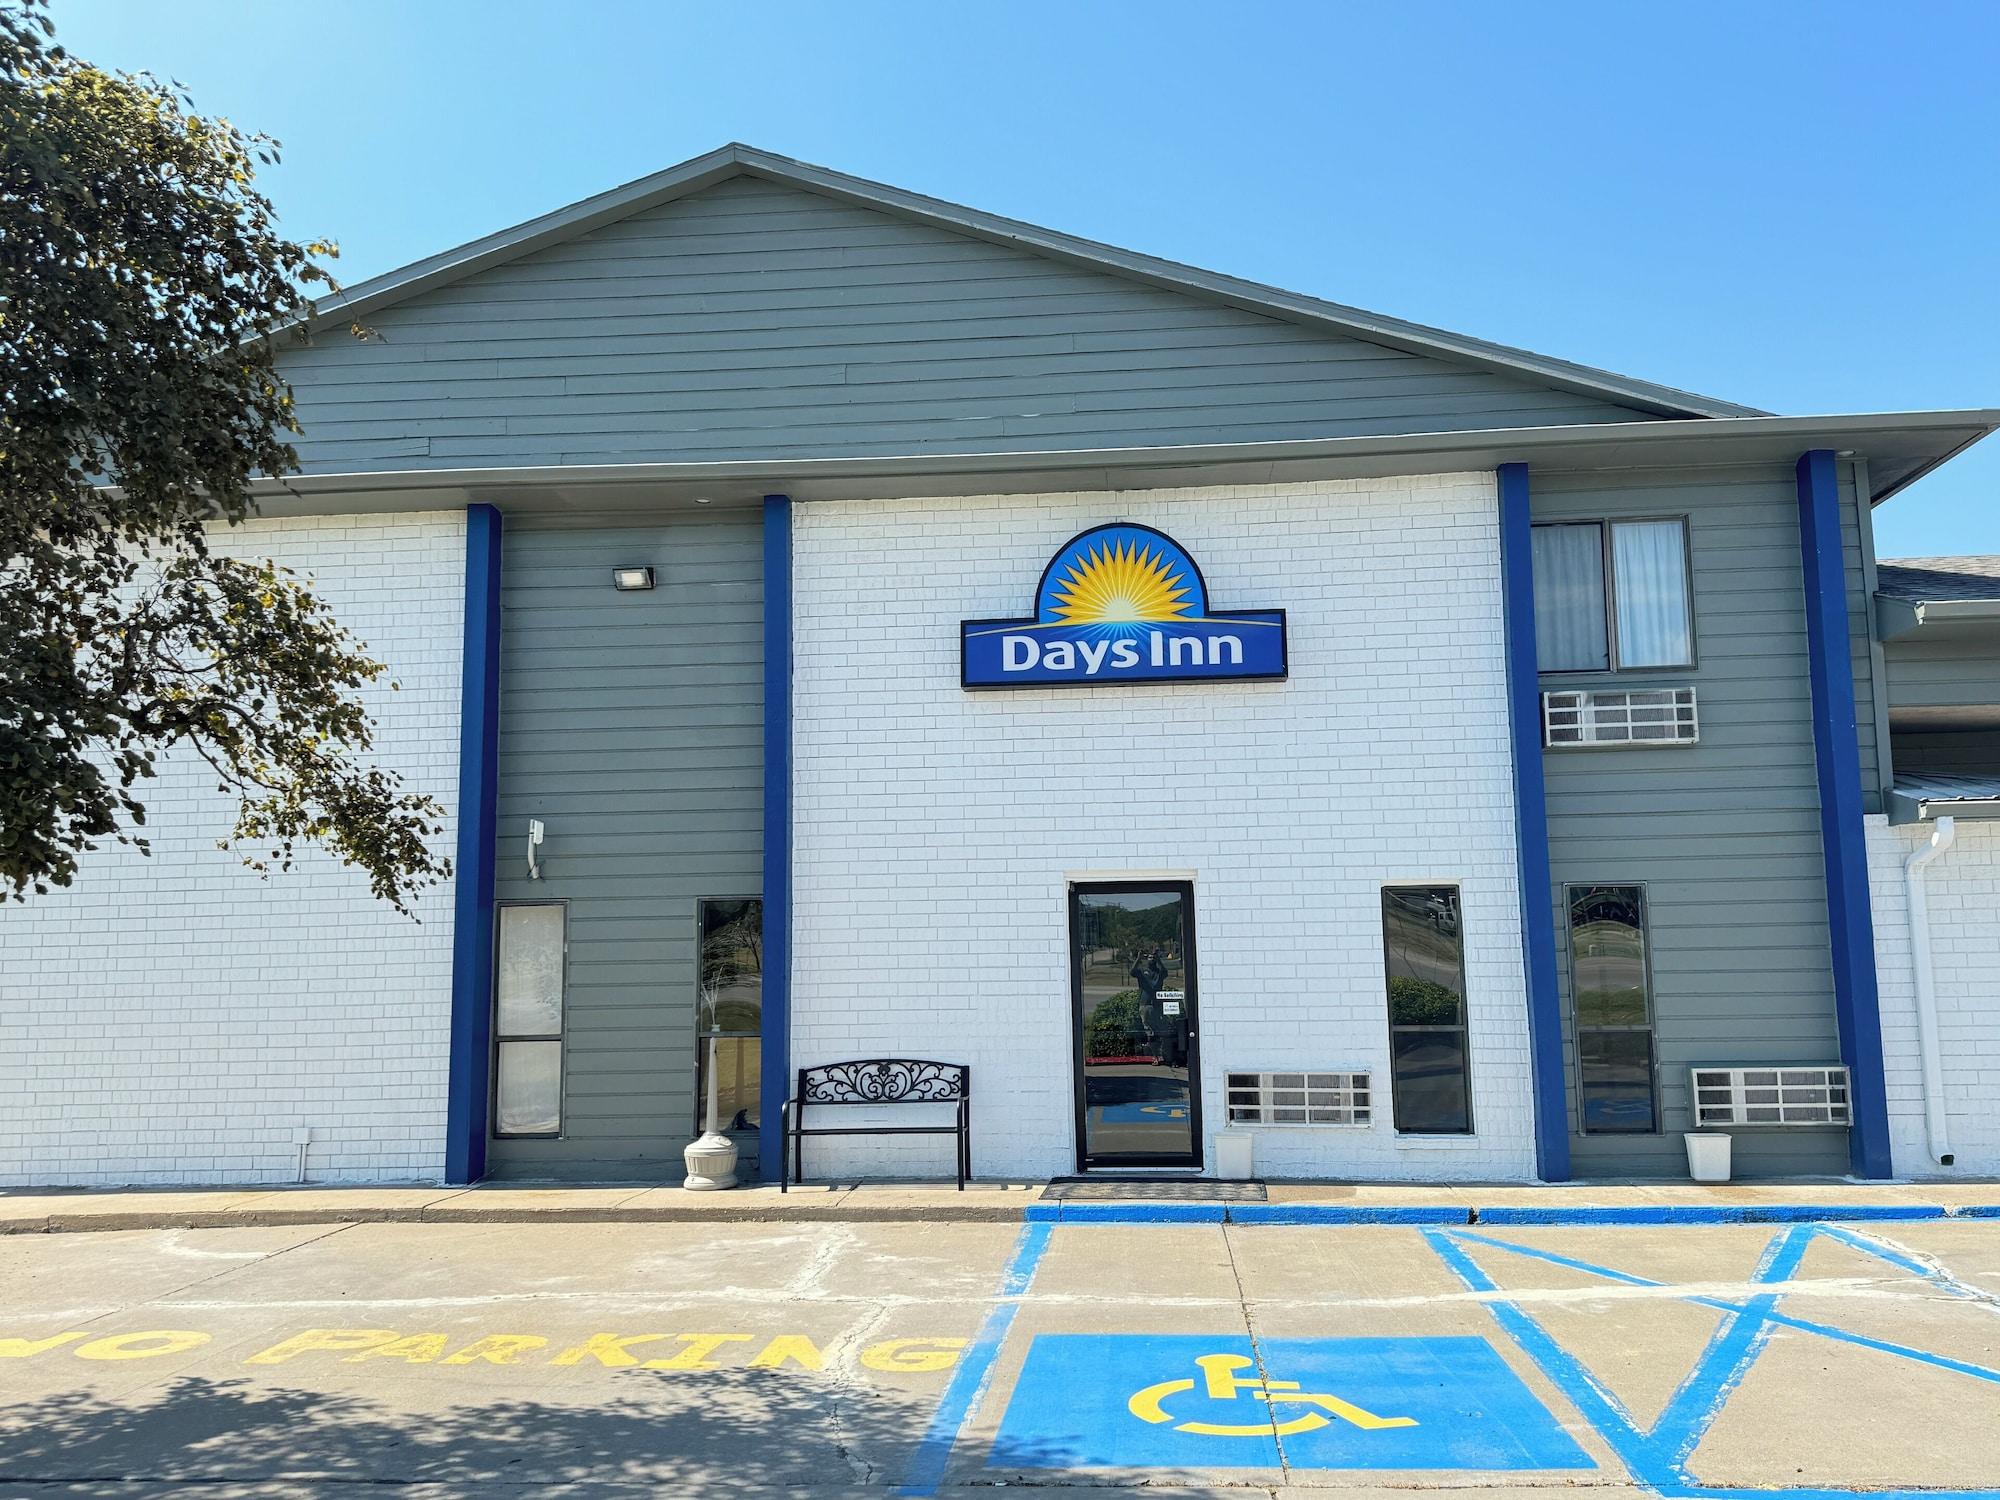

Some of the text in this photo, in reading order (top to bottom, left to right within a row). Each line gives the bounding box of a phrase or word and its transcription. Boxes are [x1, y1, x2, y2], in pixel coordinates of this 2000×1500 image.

[1002, 631, 1243, 675] Days Inn
[243, 1329, 970, 1372] PARKING
